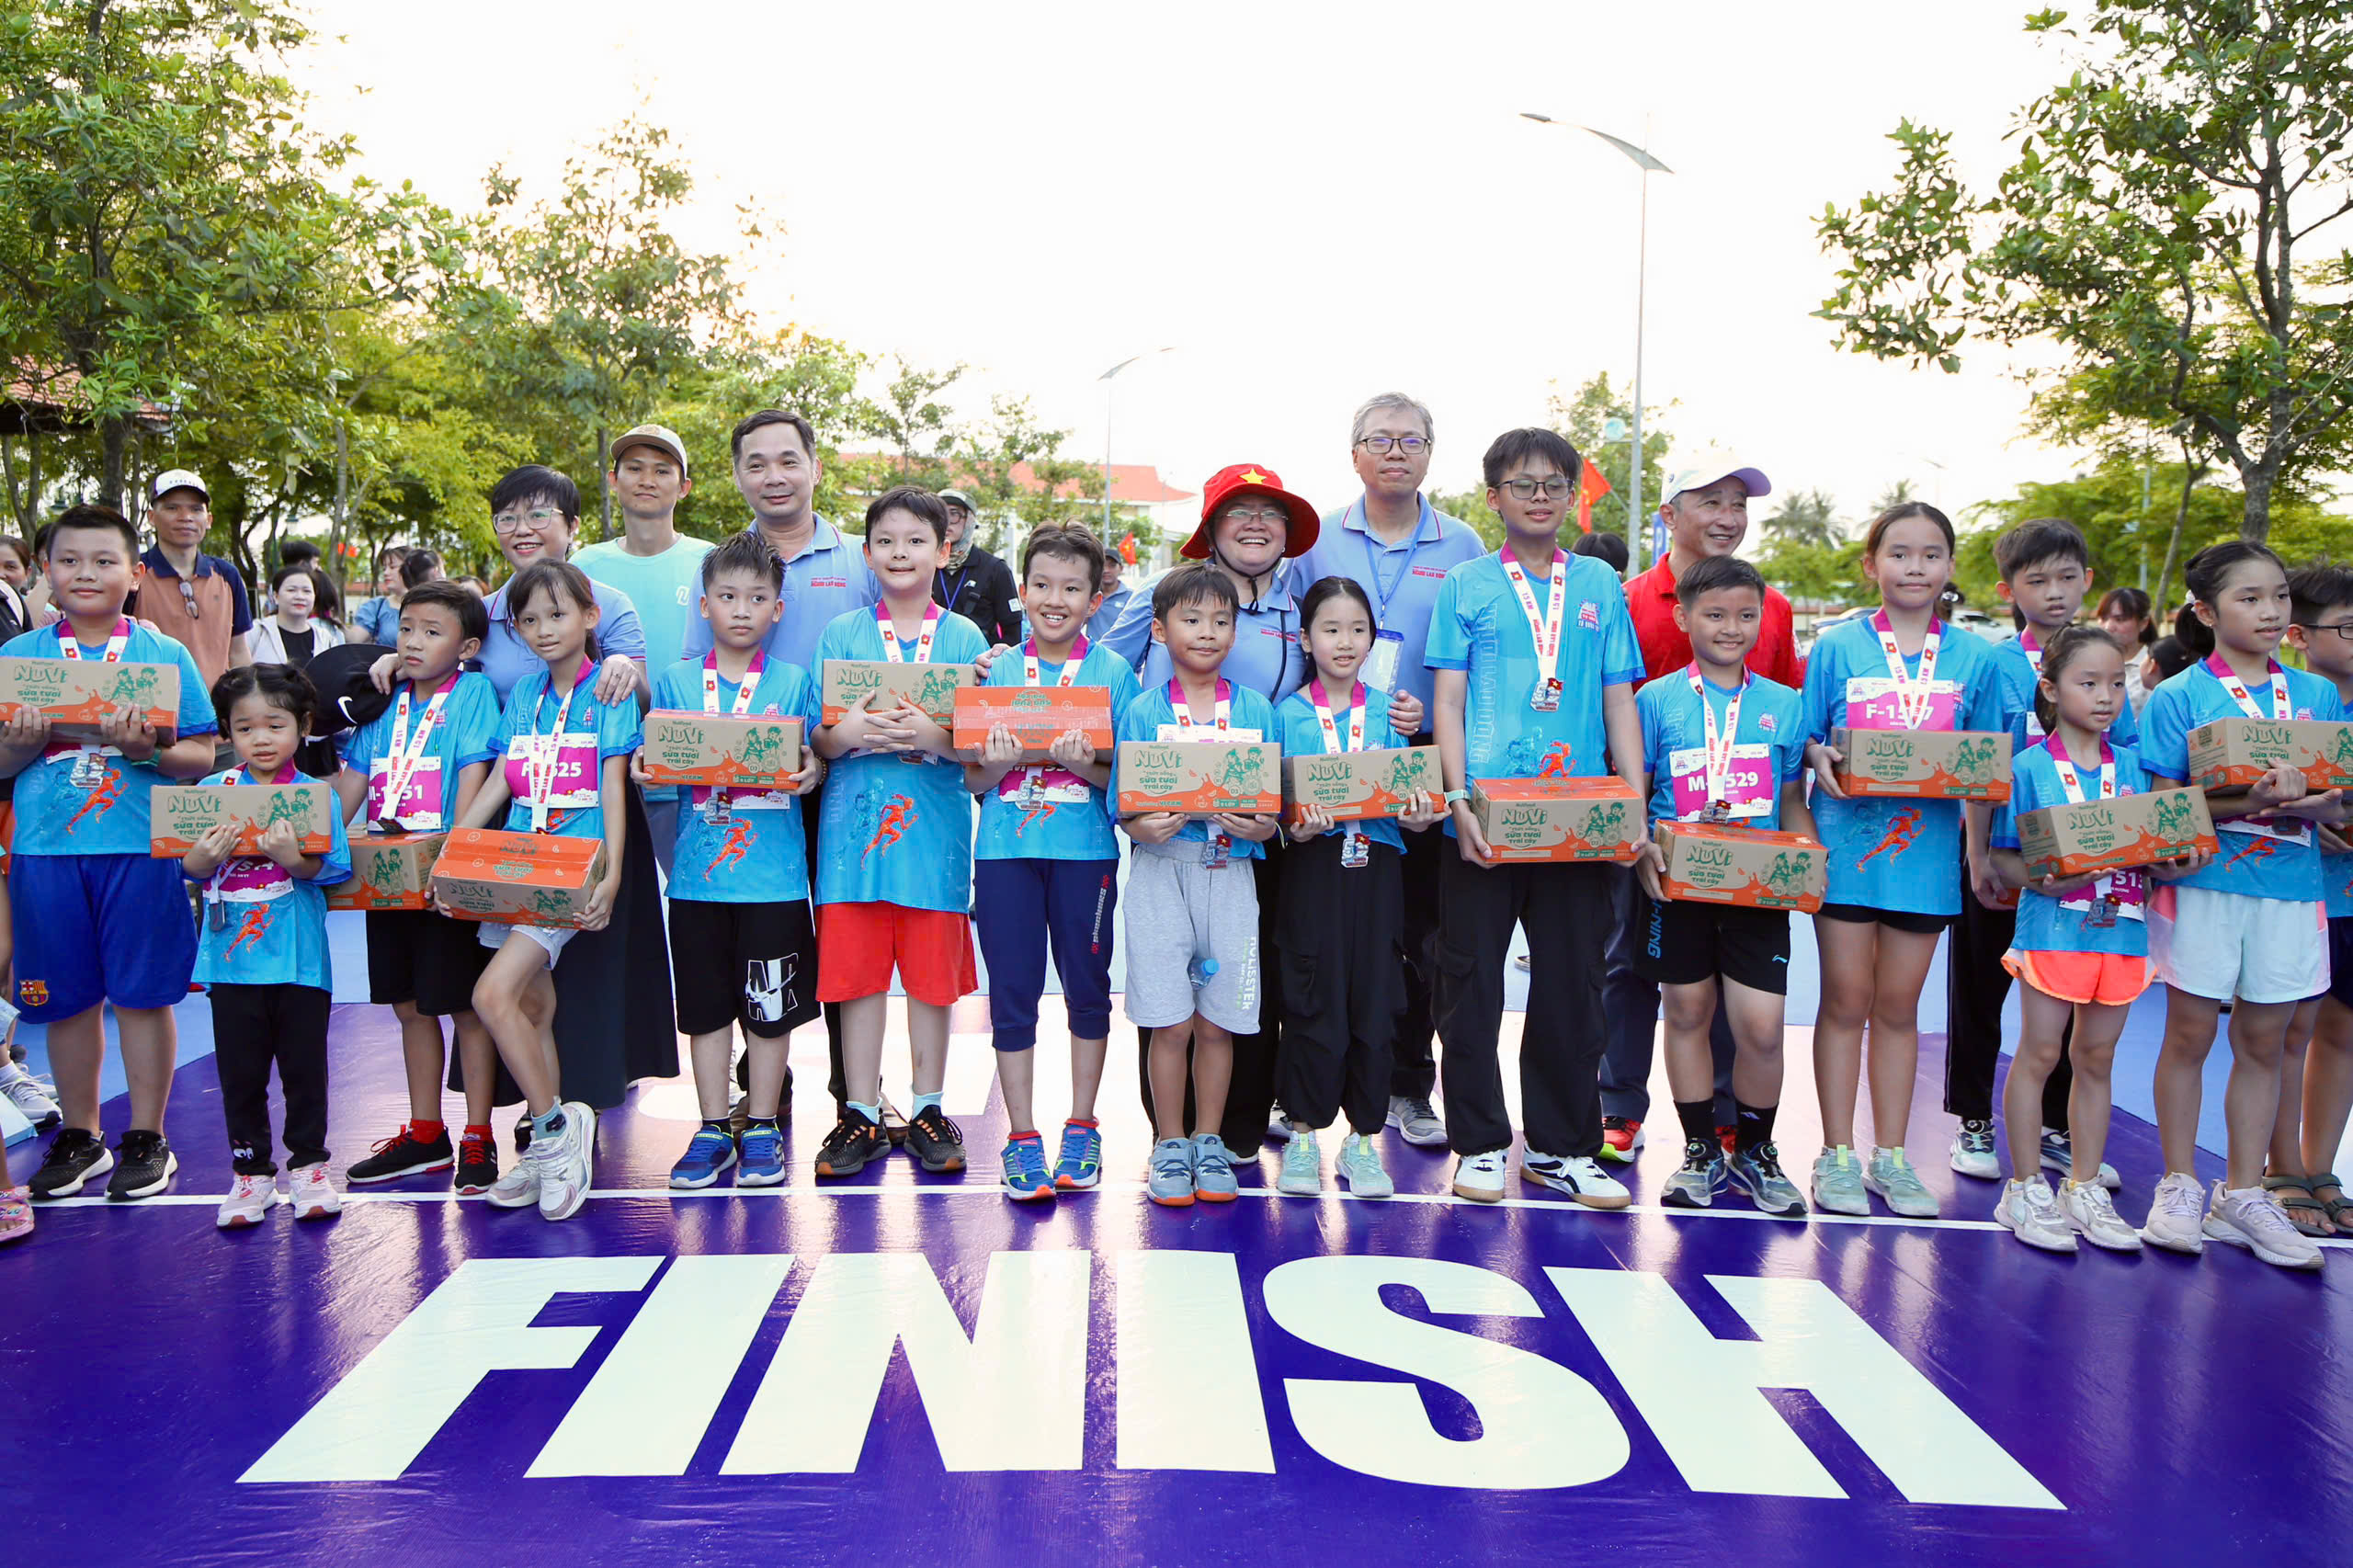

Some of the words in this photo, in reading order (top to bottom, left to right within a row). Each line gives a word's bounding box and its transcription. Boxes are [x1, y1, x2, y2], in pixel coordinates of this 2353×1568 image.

[369, 784, 424, 801] M-151
[1688, 771, 1758, 792] M-529
[1648, 900, 1662, 959] I-NING
[236, 1251, 2067, 1509] FINISH
